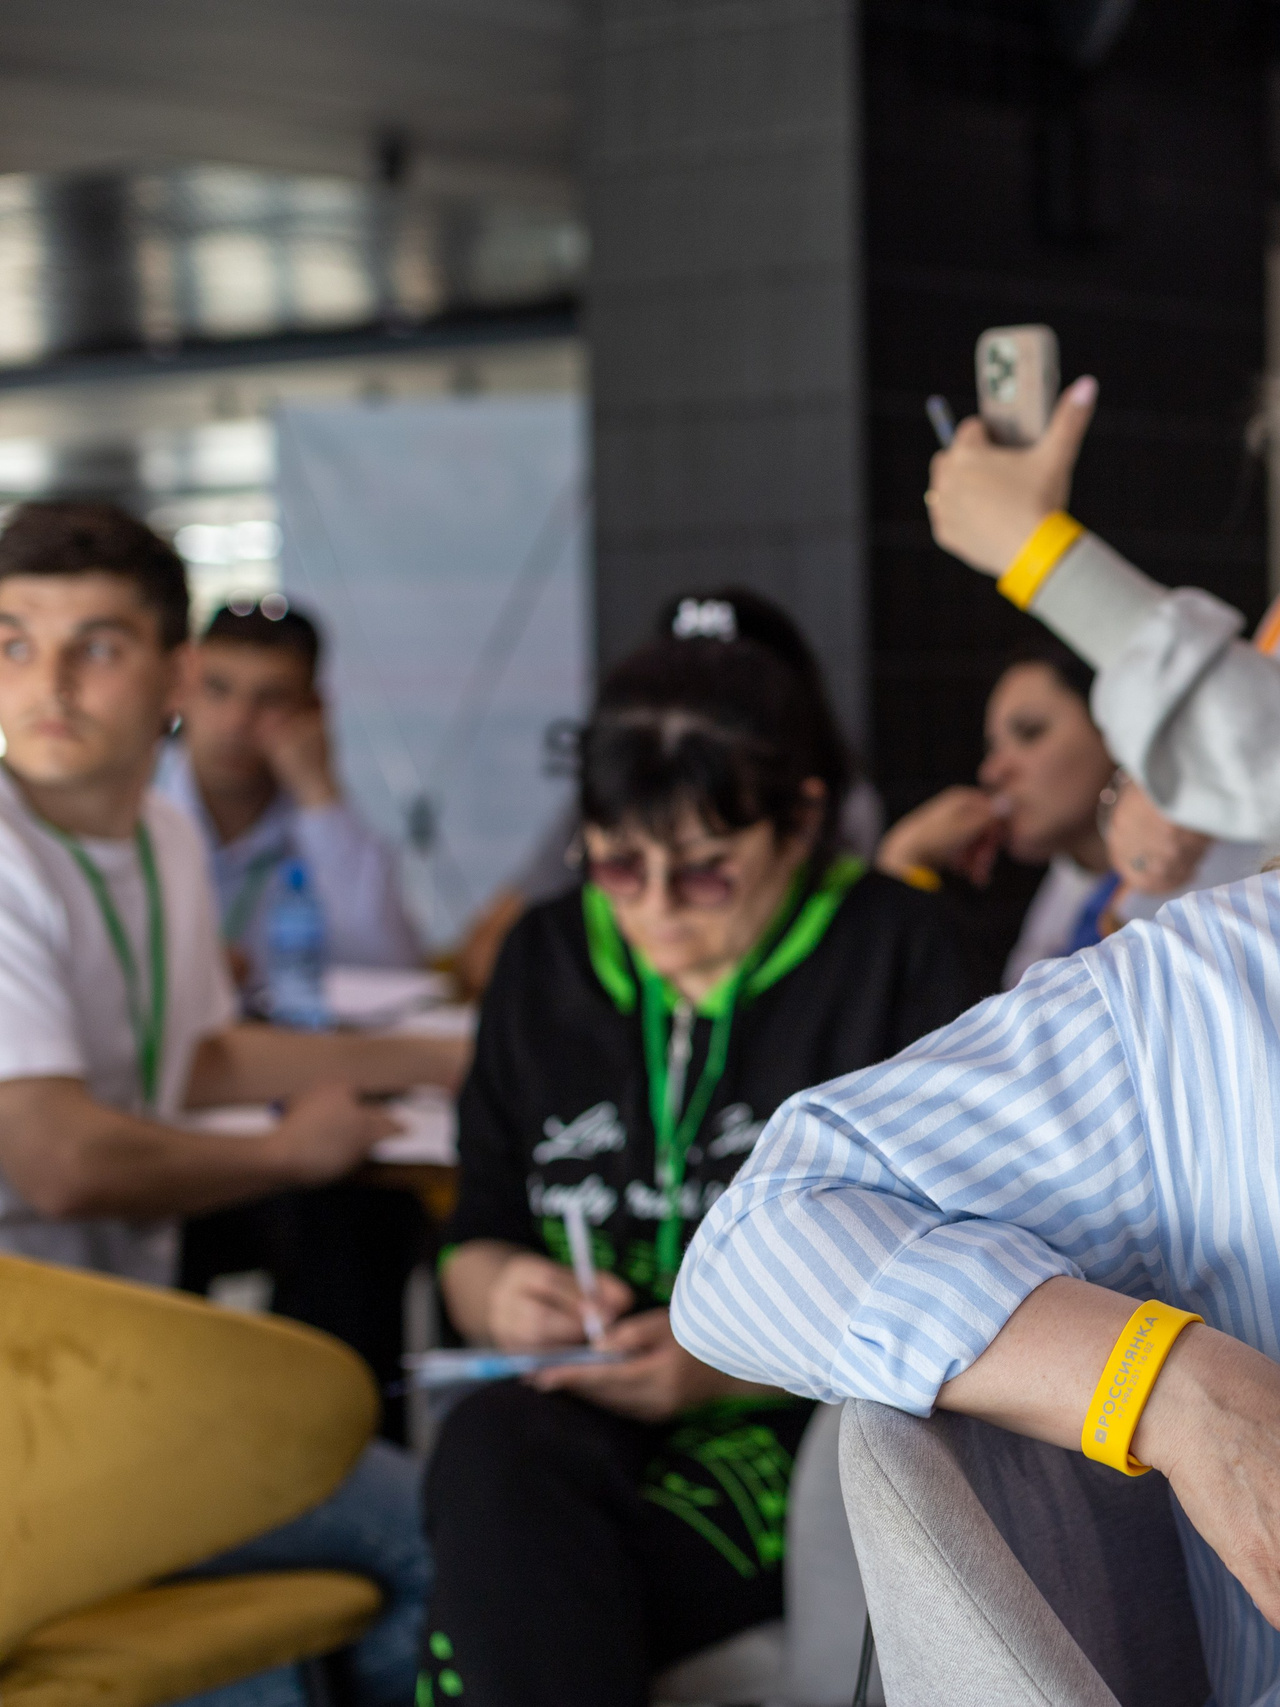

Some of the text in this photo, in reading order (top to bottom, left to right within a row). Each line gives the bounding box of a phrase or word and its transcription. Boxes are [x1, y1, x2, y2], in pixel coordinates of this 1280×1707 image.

[1098, 1316, 1159, 1428] РОССИЯНКА
[1118, 1341, 1155, 1419] +7 994 251 16 02
